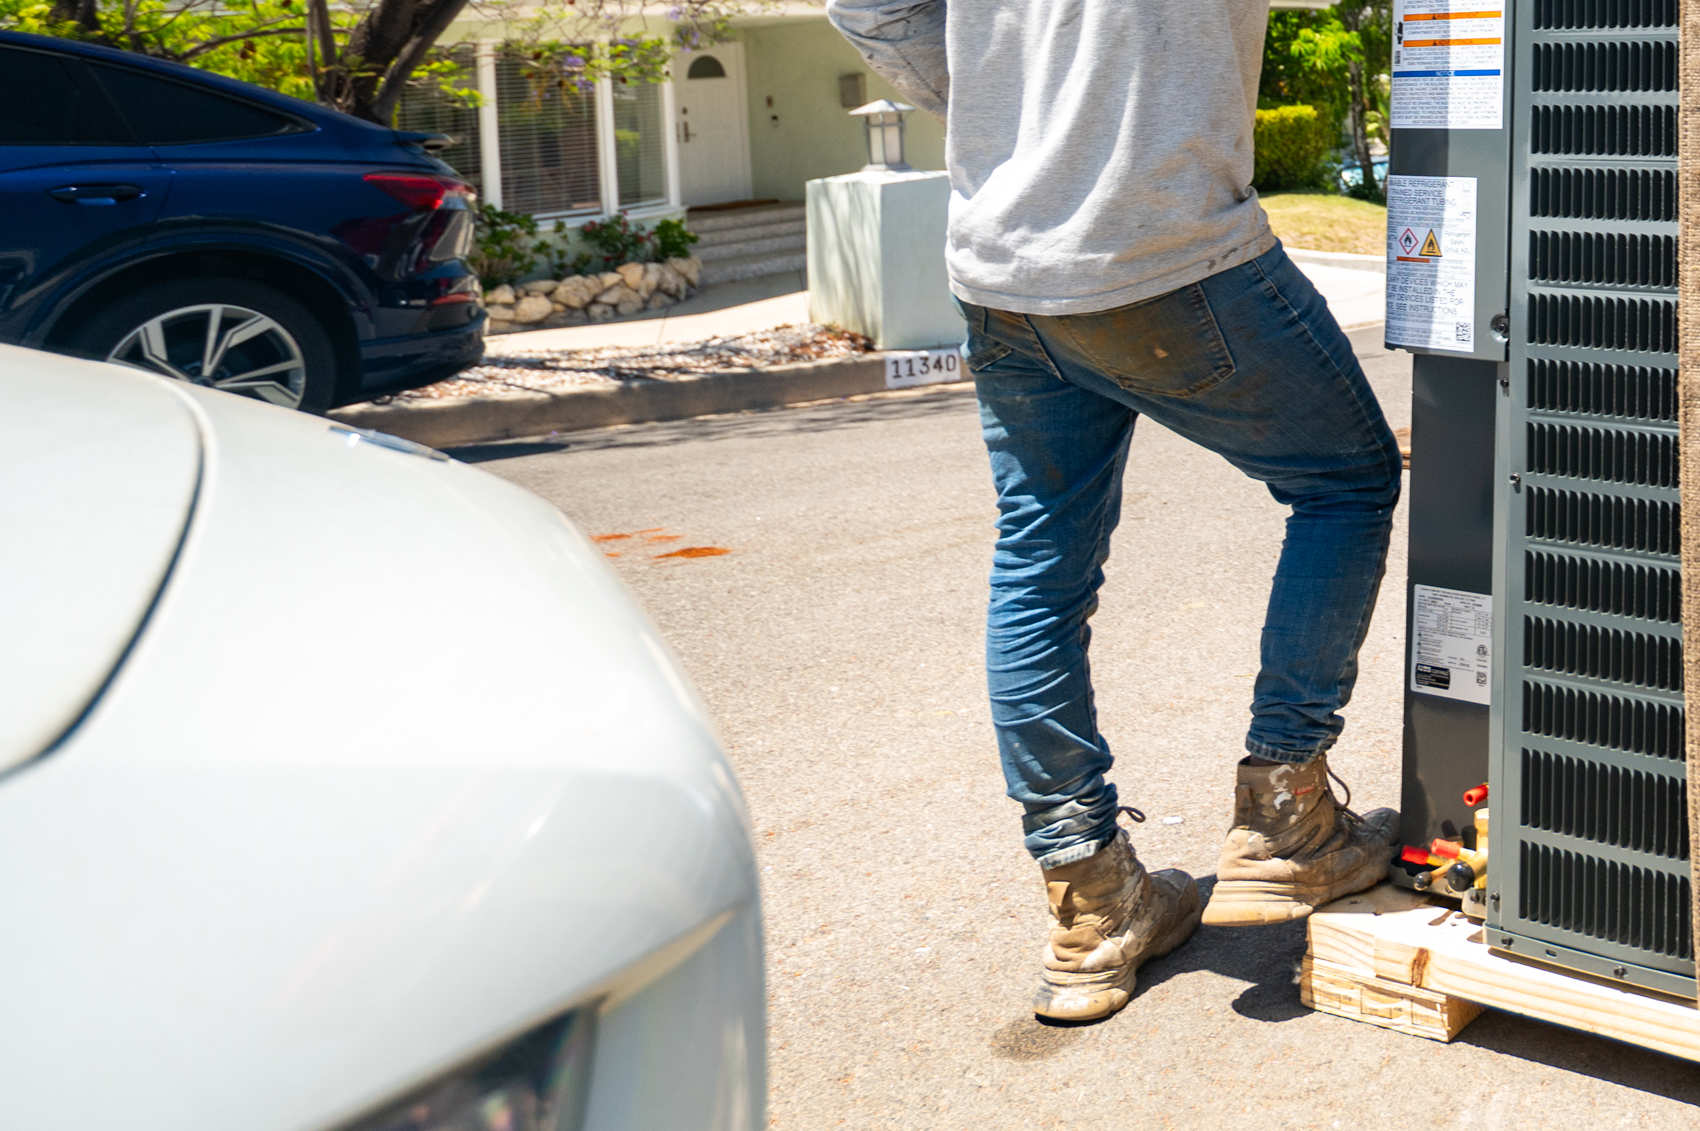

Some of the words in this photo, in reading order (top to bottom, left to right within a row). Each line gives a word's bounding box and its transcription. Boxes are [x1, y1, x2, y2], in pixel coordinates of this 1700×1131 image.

[1414, 189, 1443, 198] SERVICE
[1399, 285, 1433, 295] INSTALLED
[891, 354, 957, 379] 11340
